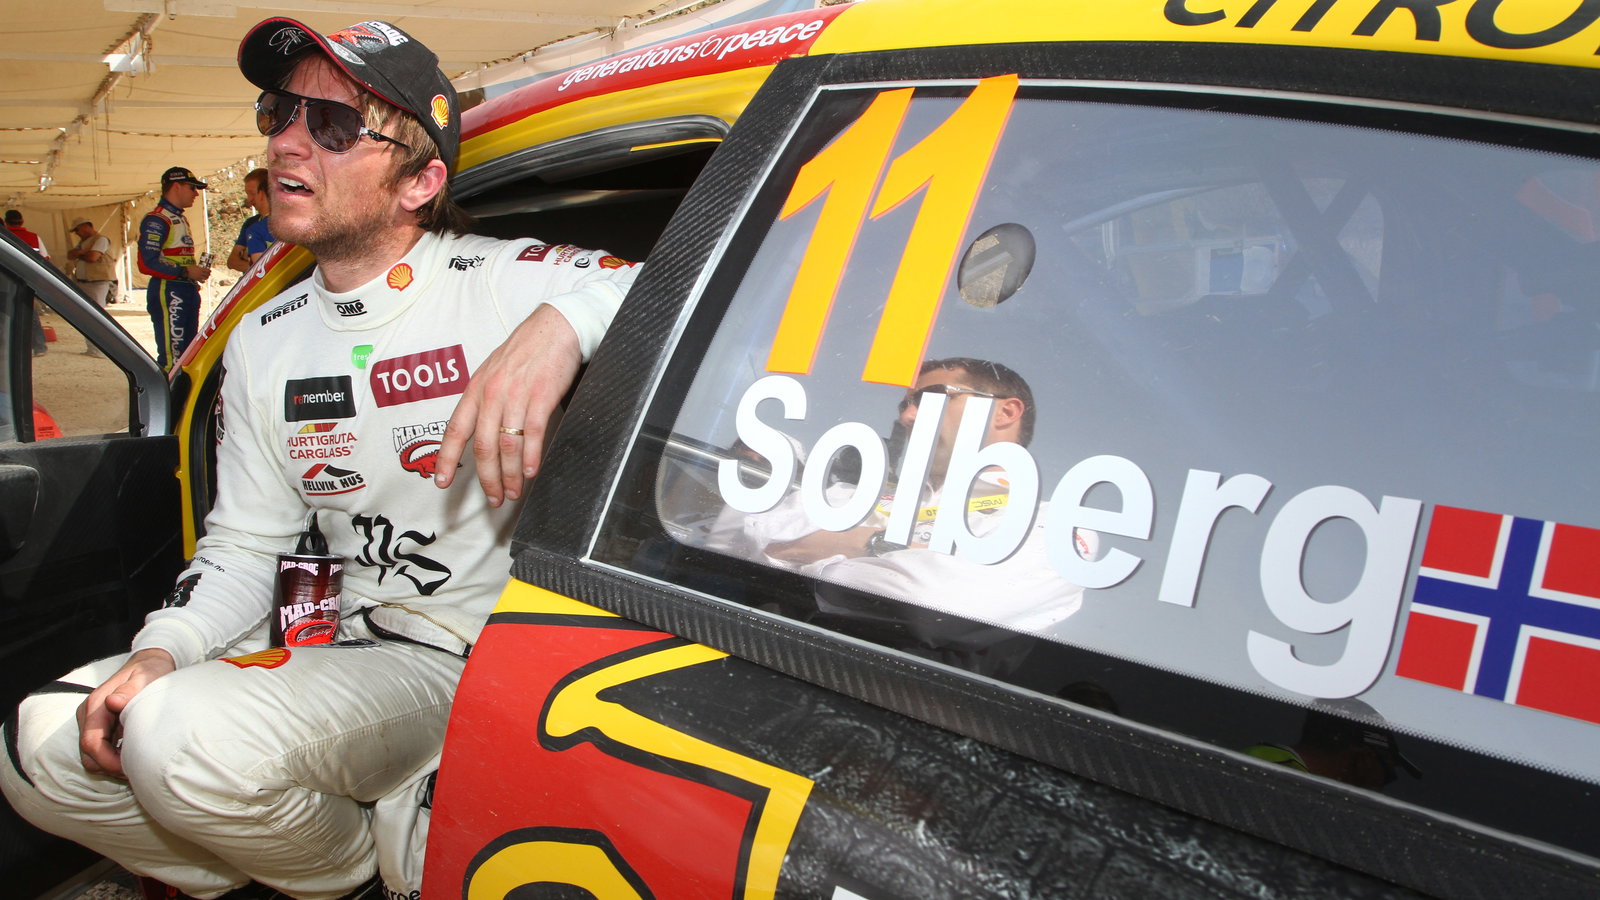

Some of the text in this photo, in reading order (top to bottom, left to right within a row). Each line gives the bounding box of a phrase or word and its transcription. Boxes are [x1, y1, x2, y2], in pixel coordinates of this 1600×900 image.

[766, 74, 1018, 388] 11
[260, 293, 308, 326] PIRELLI
[334, 299, 367, 317] OMP
[377, 358, 460, 393] TOOLS
[293, 389, 345, 405] remember
[392, 420, 451, 453] MAD-CR
[302, 473, 364, 492] HELLVIK HUS
[717, 374, 1422, 699] Solberg
[280, 560, 319, 576] MAD-CROC
[329, 563, 344, 576] MAD-
